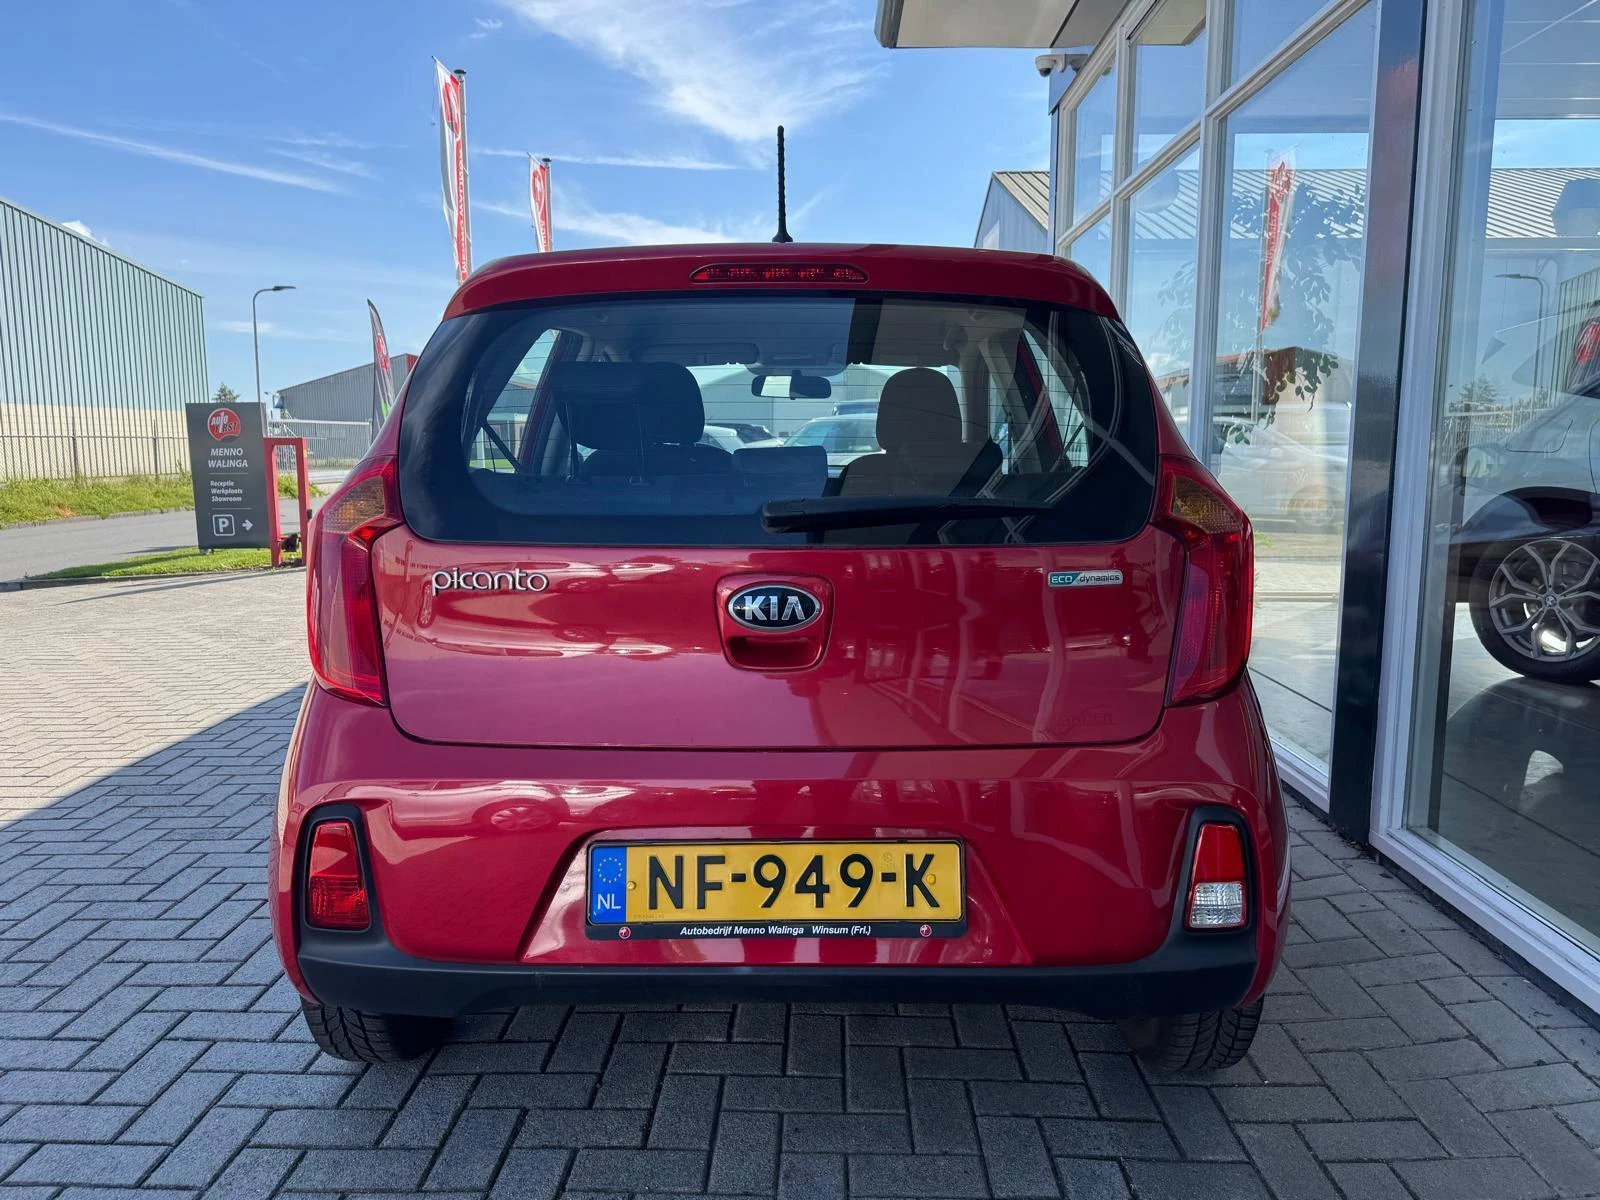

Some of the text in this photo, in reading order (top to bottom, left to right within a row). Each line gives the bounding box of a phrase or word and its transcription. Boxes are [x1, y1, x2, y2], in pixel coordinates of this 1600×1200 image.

[210, 447, 243, 456] MENNO
[208, 459, 248, 468] WALINGA
[218, 518, 230, 533] P
[431, 567, 549, 596] picanto
[1051, 573, 1120, 584] ECO dynamics
[743, 595, 806, 621] KIA
[648, 853, 941, 910] NF-949-K
[597, 893, 621, 910] NL
[680, 925, 872, 937] Autobedrijf Menno Walinga Winsum (Frl.)
